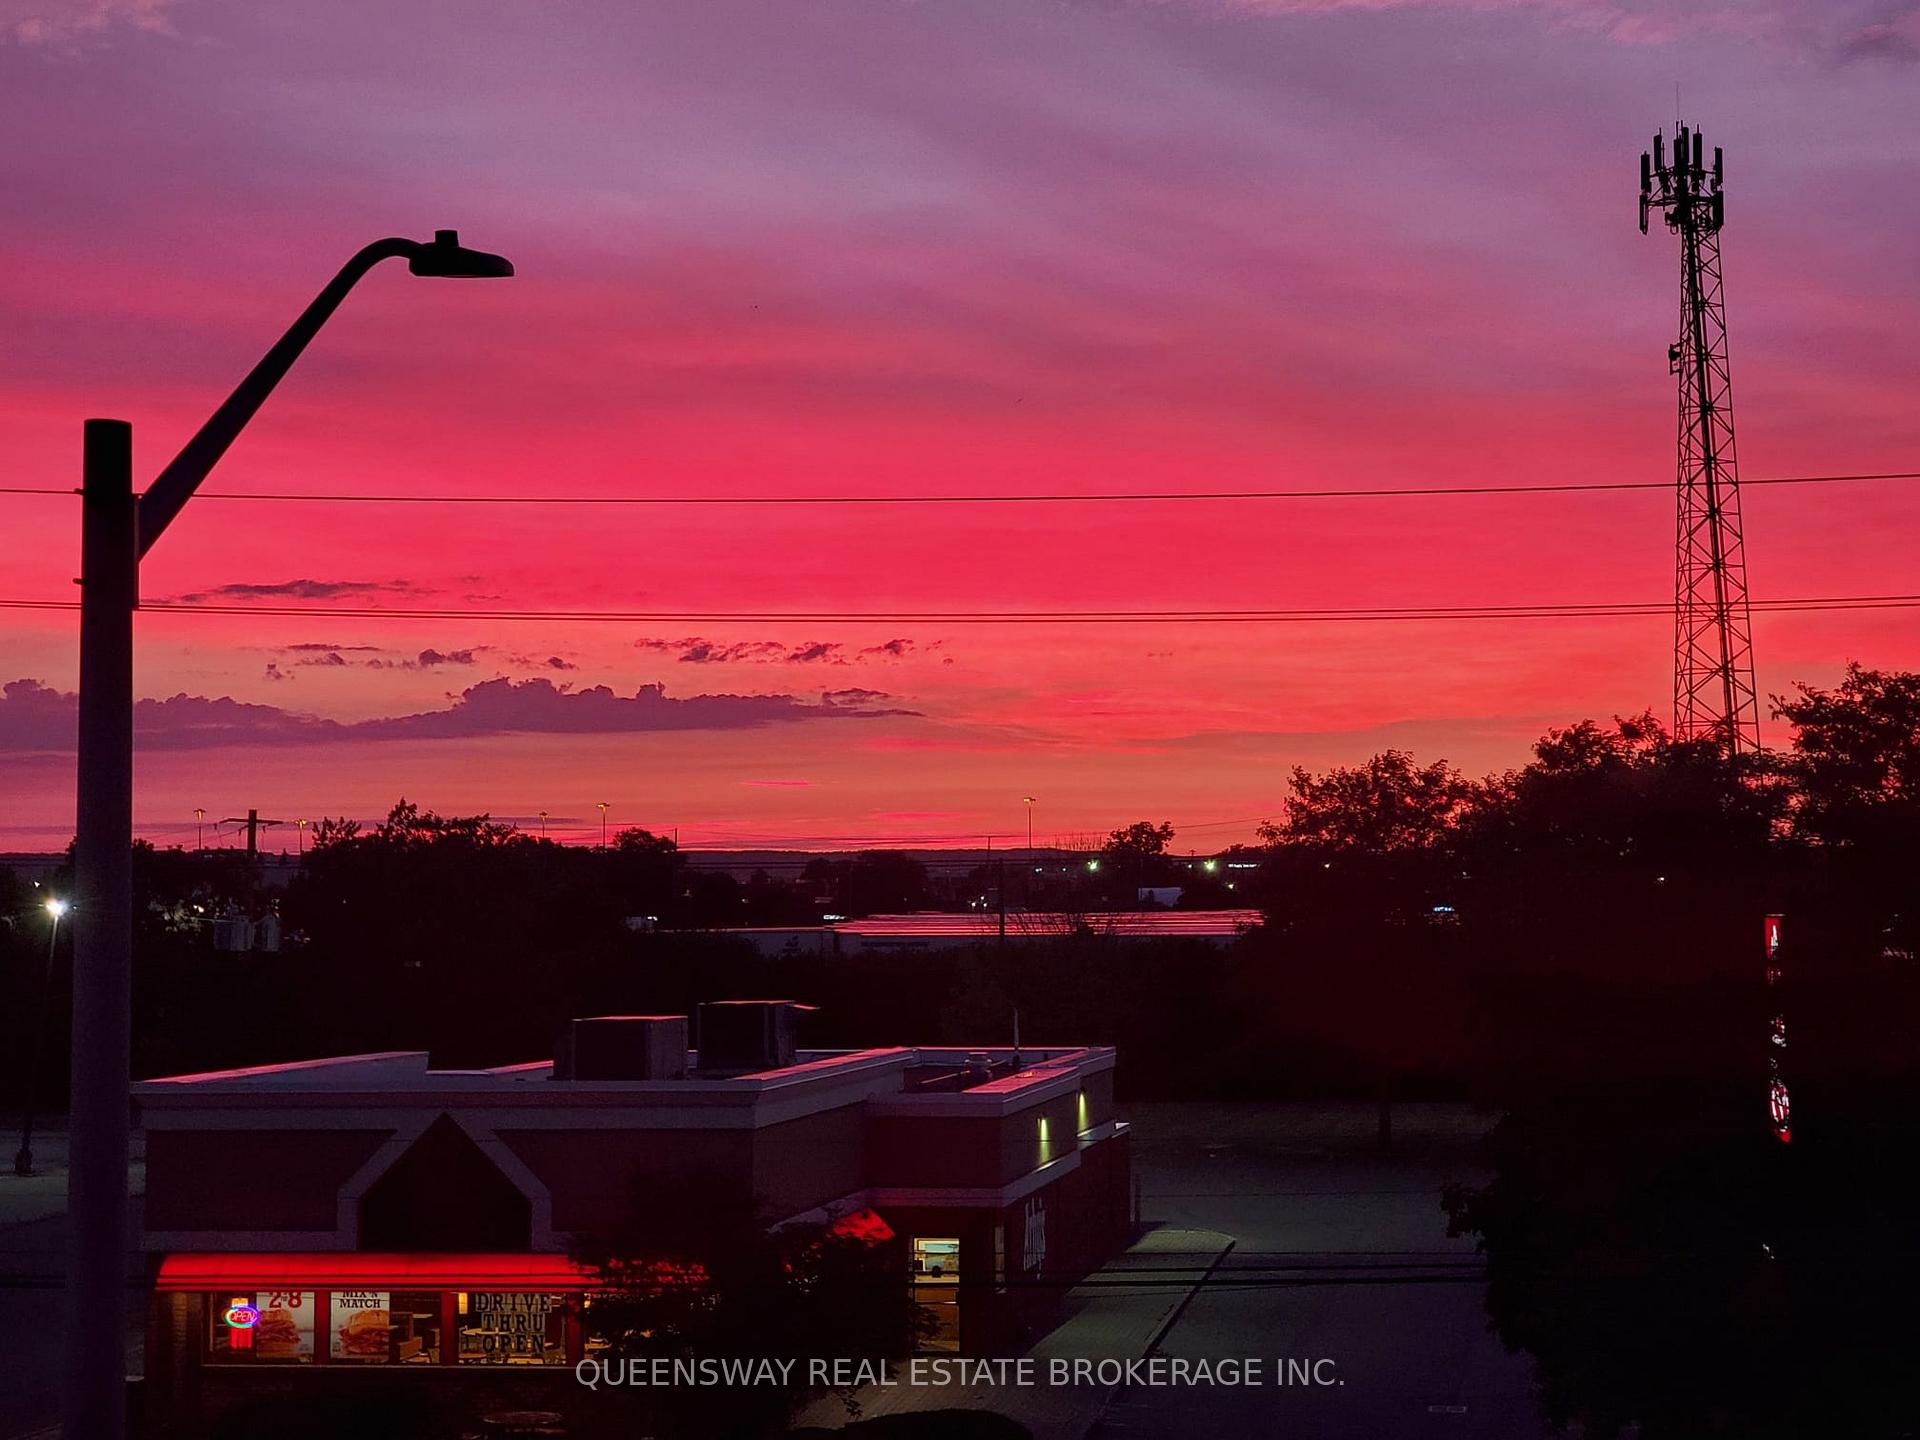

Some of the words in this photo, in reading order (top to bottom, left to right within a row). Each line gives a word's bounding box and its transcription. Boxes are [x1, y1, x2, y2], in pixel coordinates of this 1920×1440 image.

[269, 1291, 282, 1308] 2
[288, 1291, 302, 1308] 8
[340, 1298, 381, 1308] MATCH
[477, 1293, 550, 1312] DRIVE
[230, 1309, 256, 1322] OPEN
[483, 1313, 544, 1332] THRU
[482, 1334, 544, 1353] OPEN
